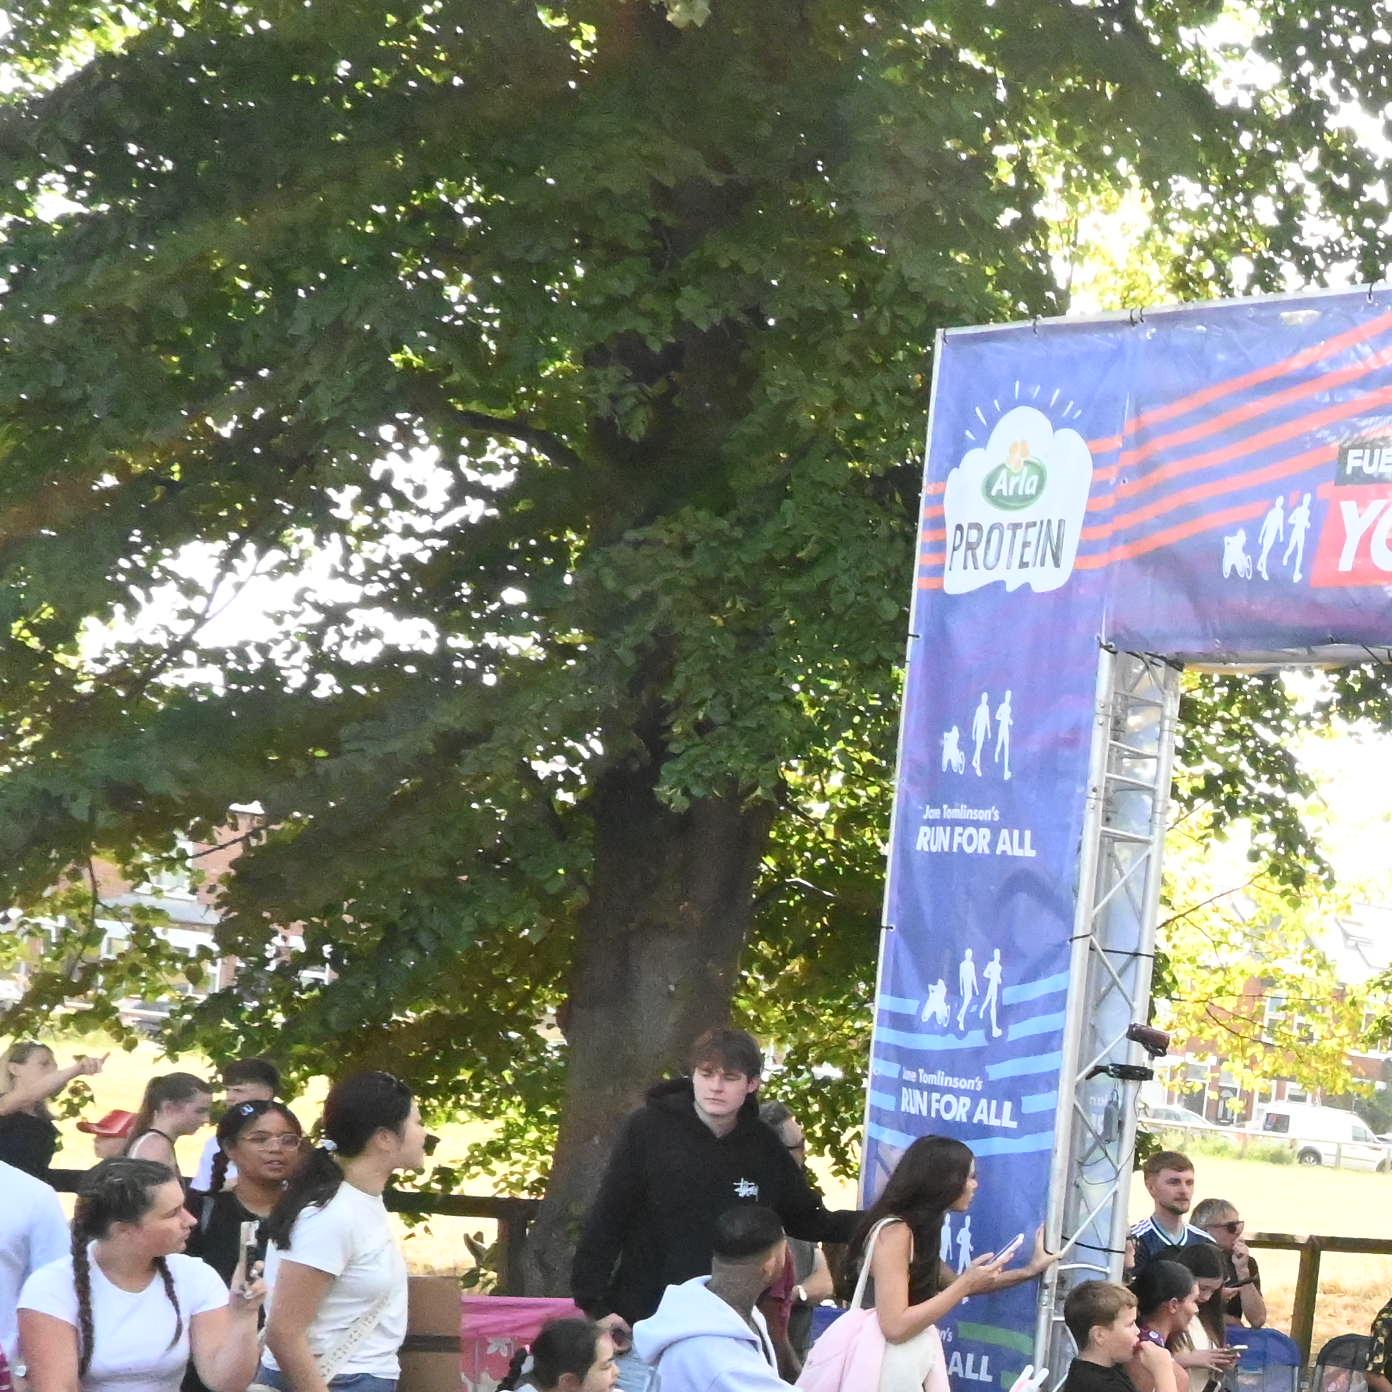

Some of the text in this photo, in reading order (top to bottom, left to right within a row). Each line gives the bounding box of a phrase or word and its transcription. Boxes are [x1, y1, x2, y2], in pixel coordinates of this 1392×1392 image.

[990, 465, 1041, 497] Arla
[948, 518, 1067, 572] PROTEIN
[942, 804, 1001, 822] Tomlinson's
[915, 825, 1037, 858] RUN FOR ALL
[918, 1068, 984, 1092] Tomlinson's
[901, 1087, 1018, 1129] RUN FOR ALL
[947, 1351, 993, 1383] ALL
